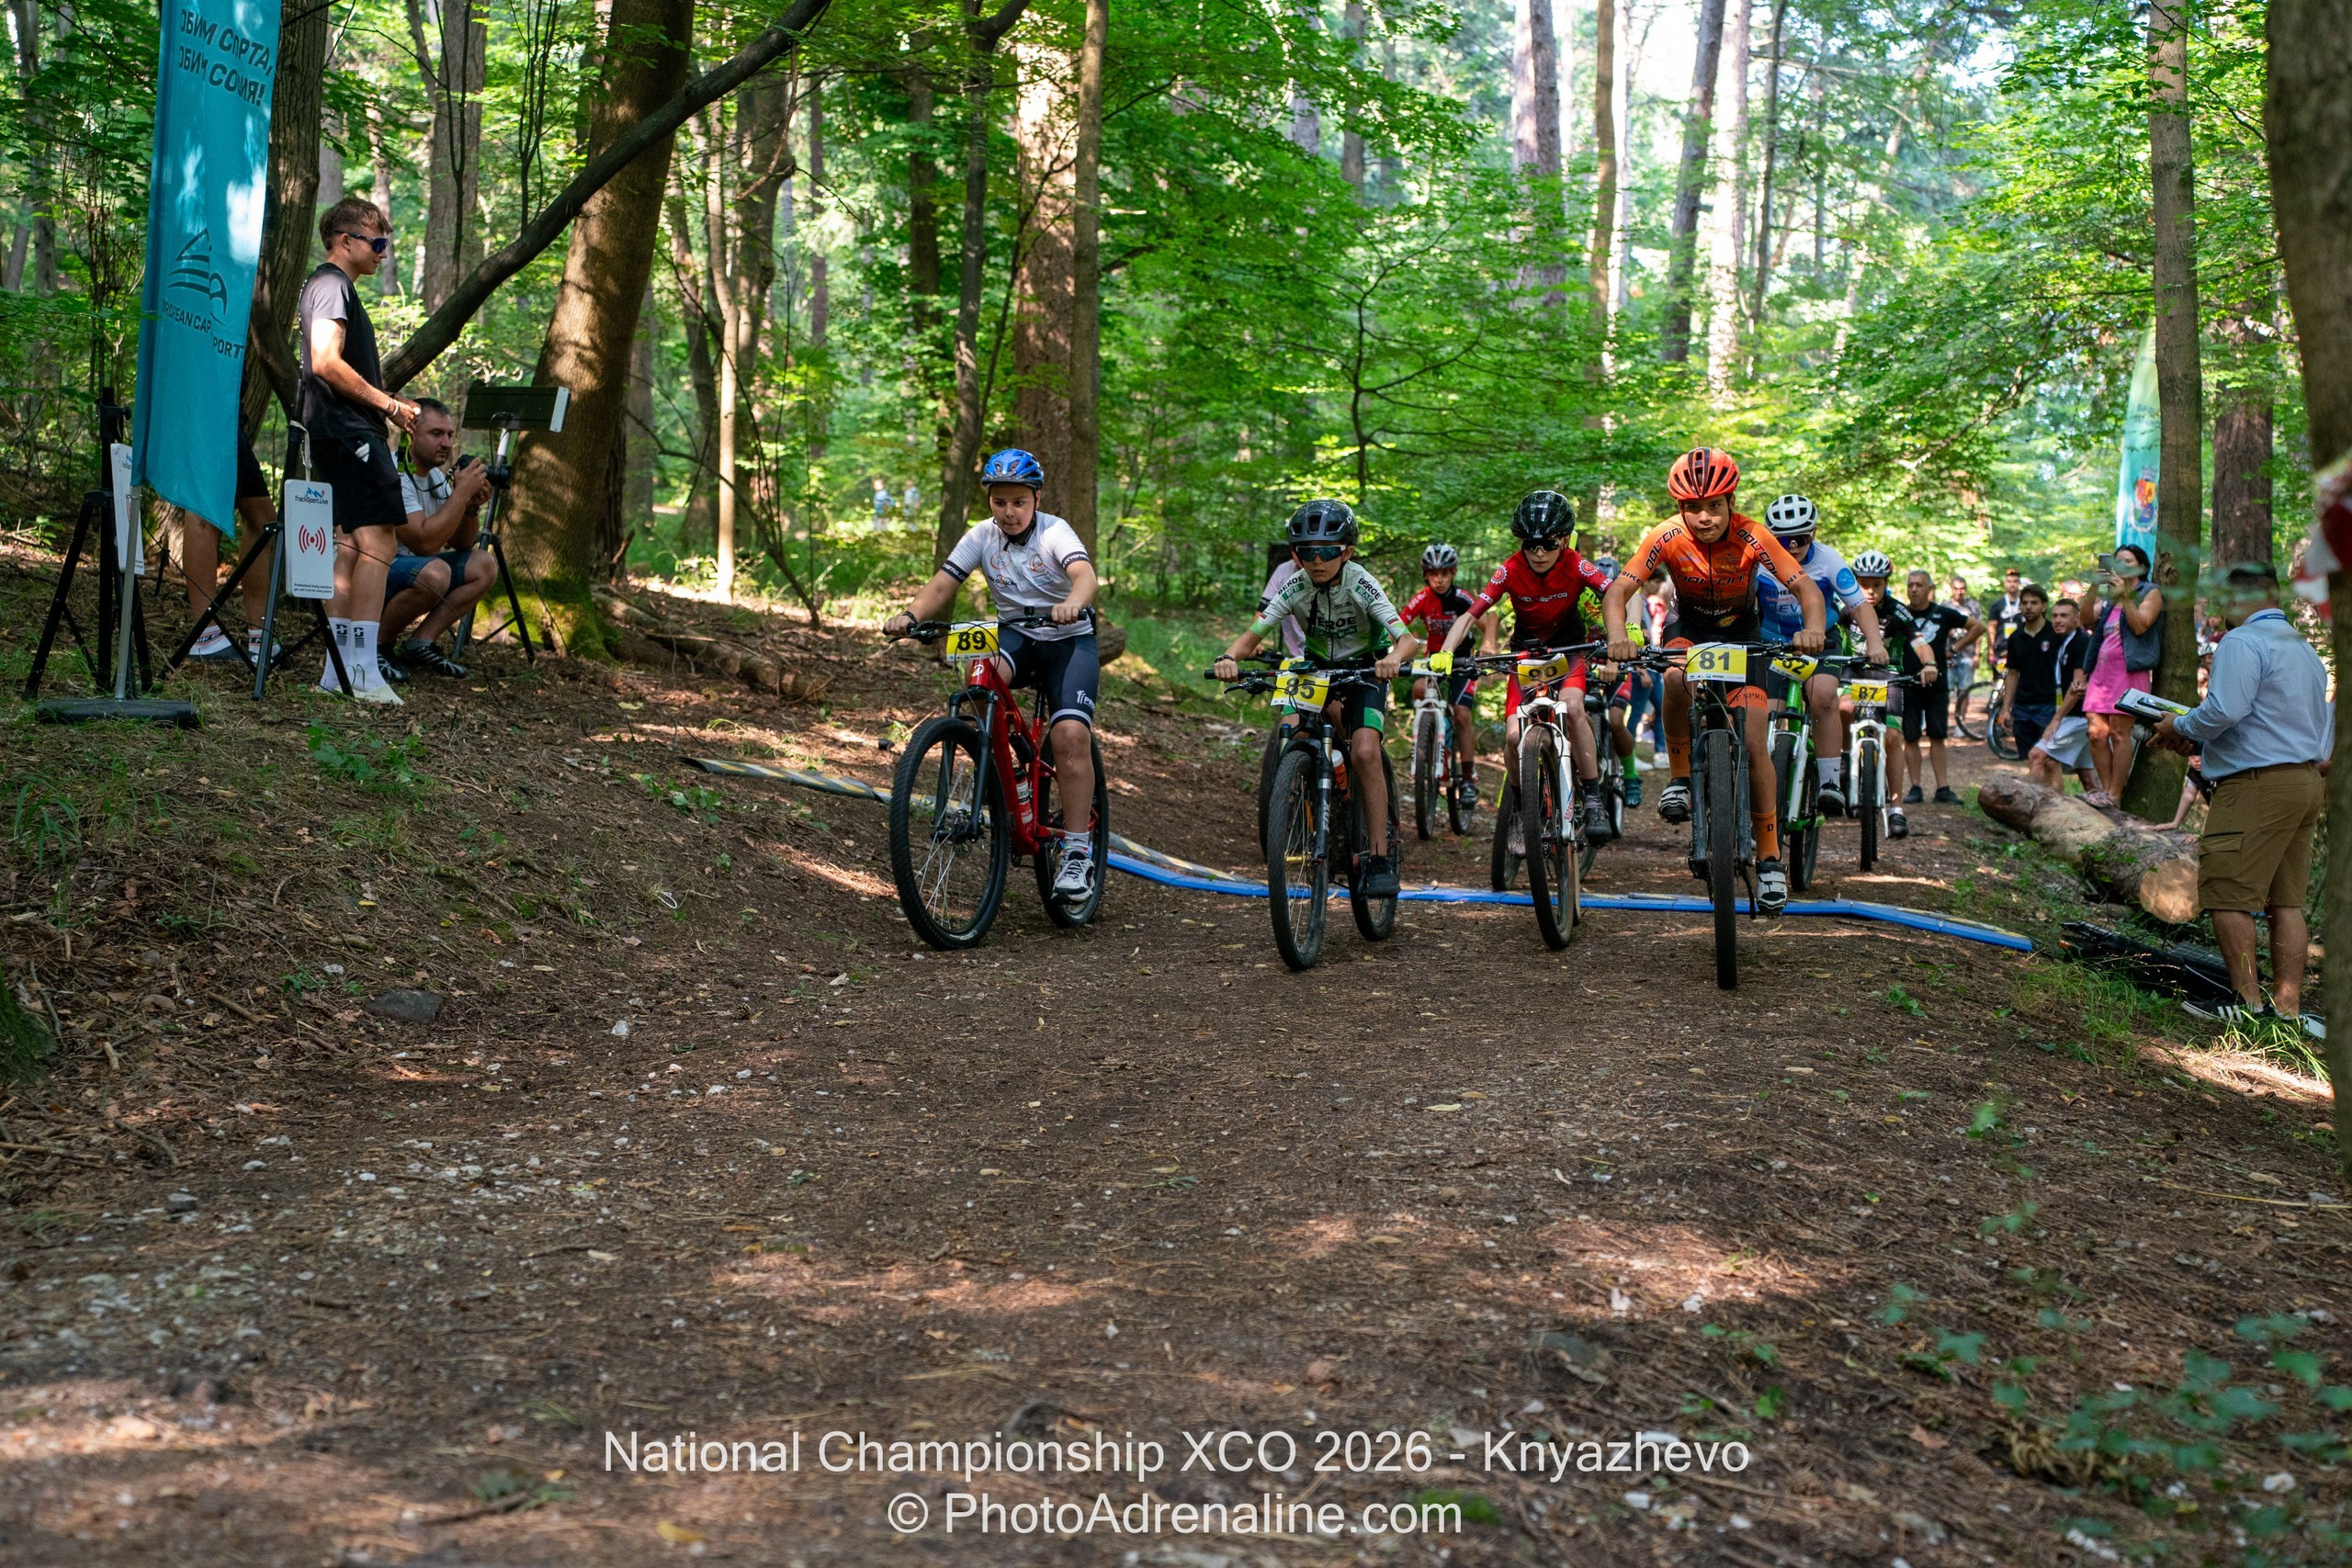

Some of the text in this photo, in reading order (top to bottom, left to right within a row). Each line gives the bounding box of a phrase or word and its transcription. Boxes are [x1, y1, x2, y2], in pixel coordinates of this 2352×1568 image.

[1358, 578, 1382, 601] BEROE
[957, 630, 987, 651] 89
[1700, 650, 1730, 671] 81
[1284, 677, 1316, 700] 85
[1859, 686, 1879, 700] 87
